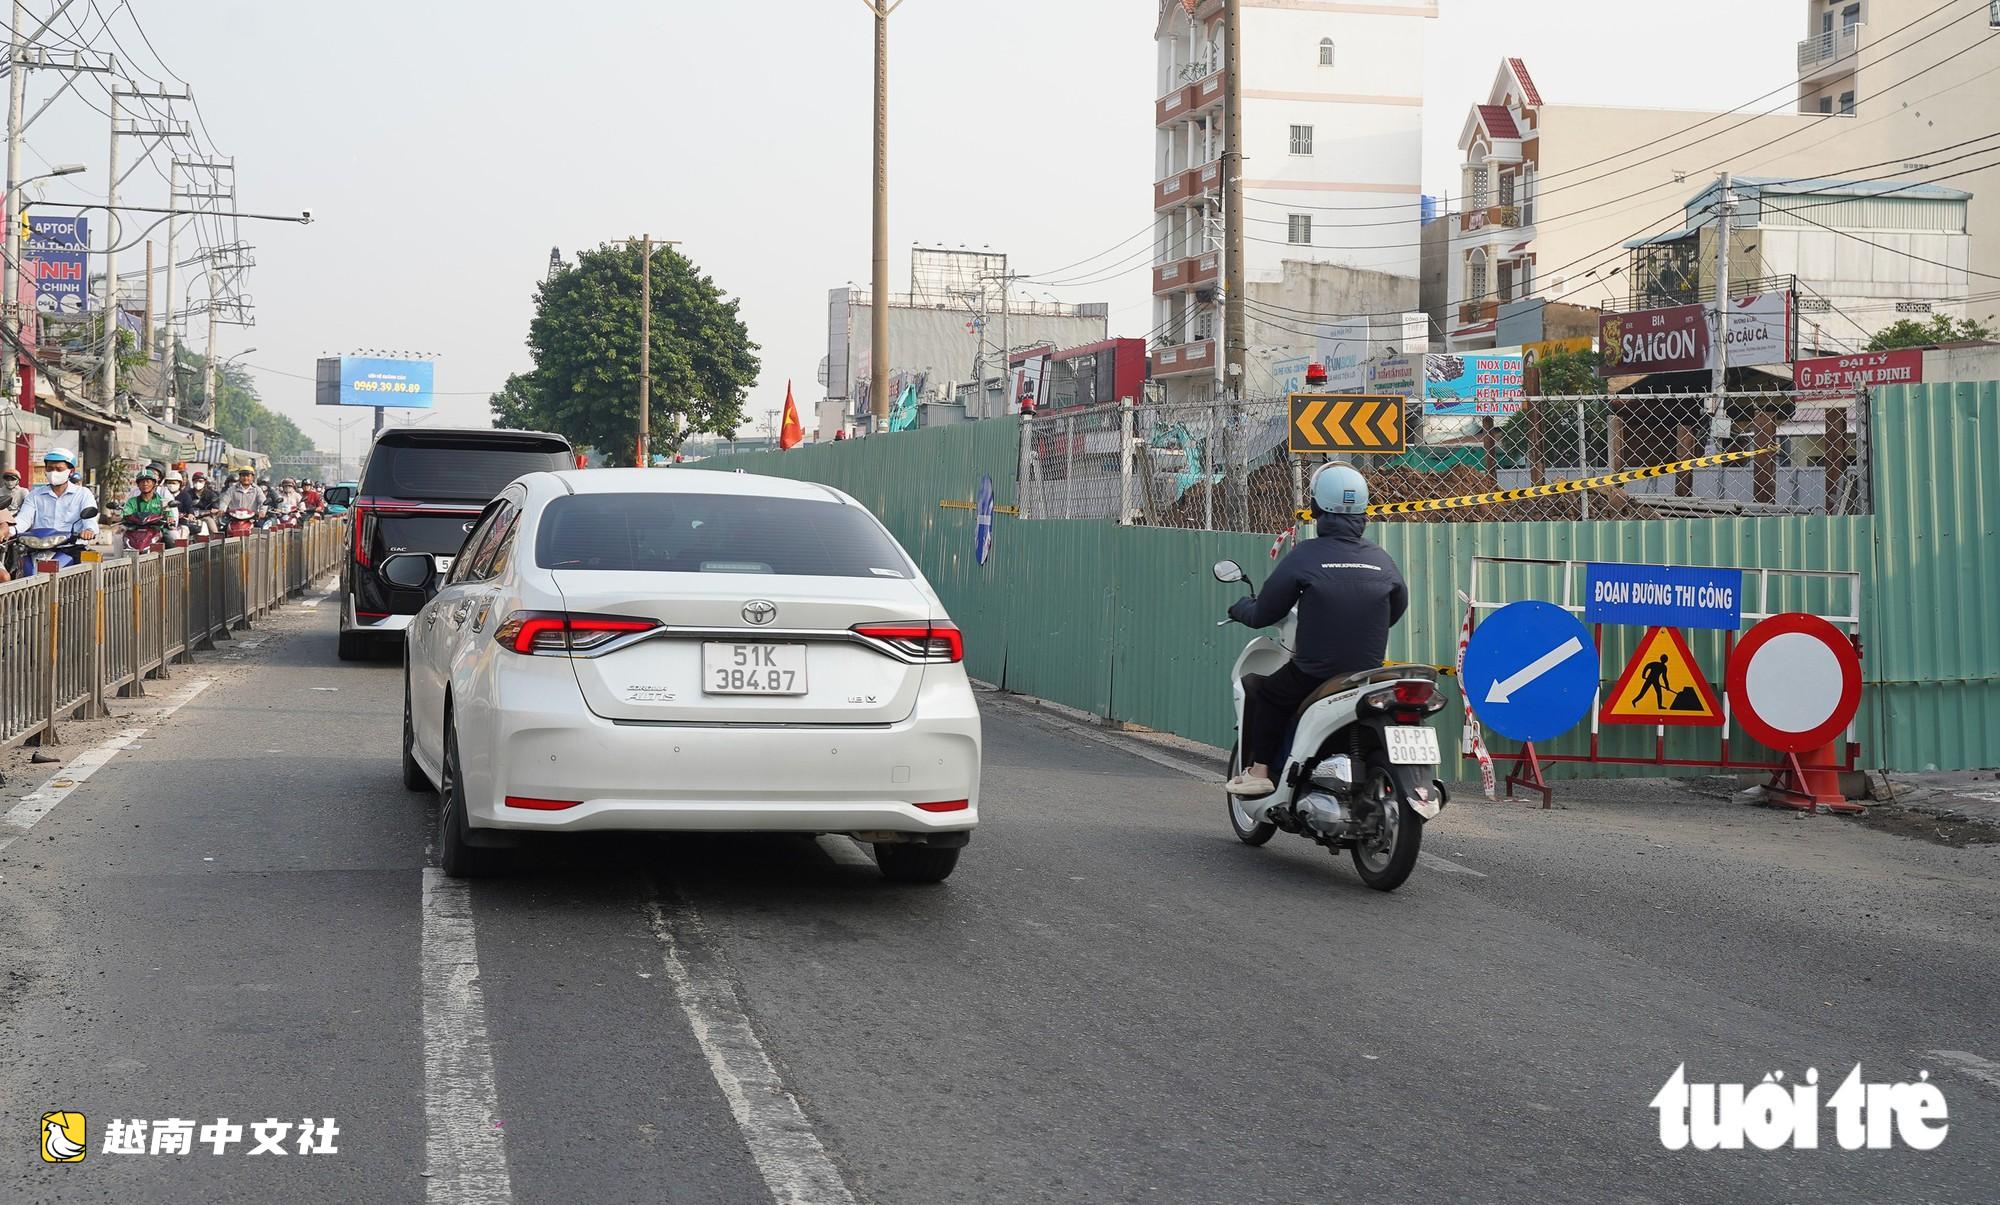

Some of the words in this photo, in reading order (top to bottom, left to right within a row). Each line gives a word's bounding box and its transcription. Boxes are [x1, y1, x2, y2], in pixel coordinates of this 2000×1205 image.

[1651, 315, 1665, 327] BIA
[1622, 328, 1696, 364] SAIGON
[1477, 360, 1500, 370] INOX
[1839, 358, 1864, 369] ĐẠI
[1868, 353, 1888, 366] LÝ
[1844, 369, 1873, 384] NAM
[1877, 366, 1912, 384] ĐỊNH
[1594, 580, 1630, 605] ĐOẠN
[1631, 579, 1673, 606] ĐƯỜNG
[1674, 585, 1696, 607] THI
[1697, 581, 1733, 610] CÔNG
[733, 645, 777, 667] 51K
[715, 669, 796, 691] 384.87
[1392, 729, 1429, 745] 81-P1
[1391, 745, 1437, 762] 300.35
